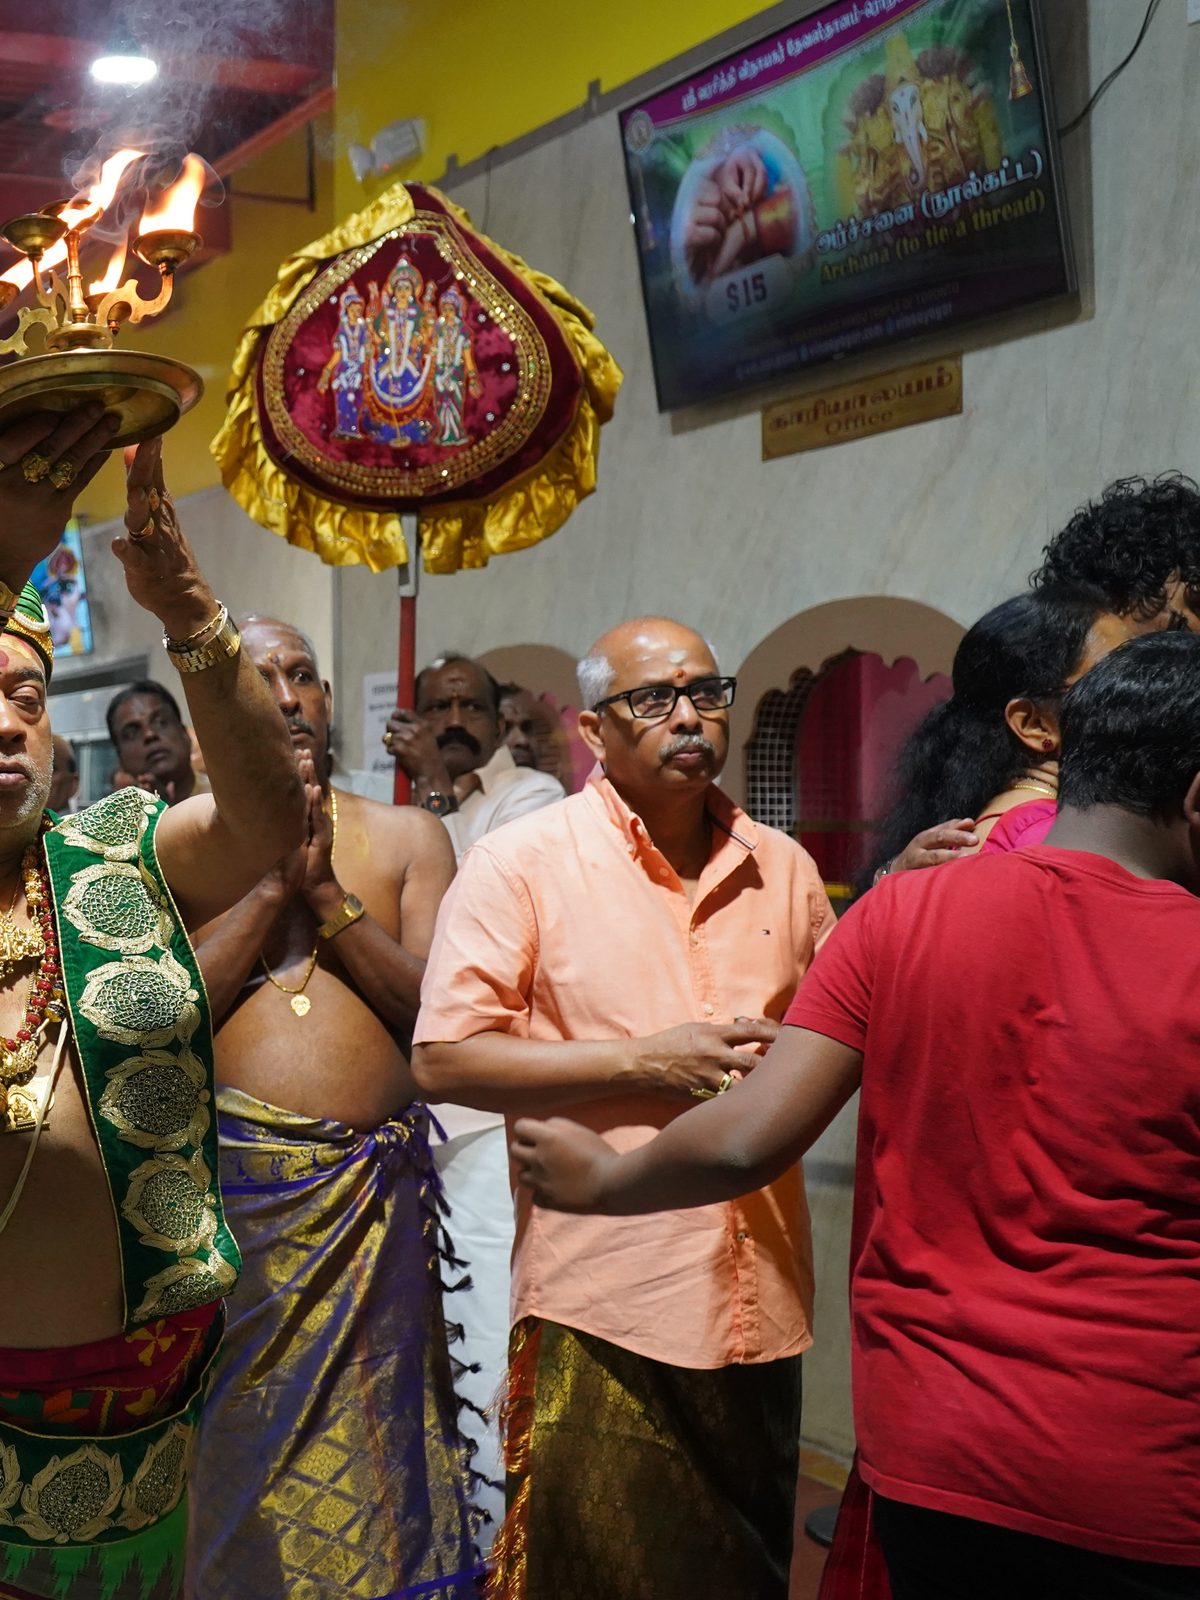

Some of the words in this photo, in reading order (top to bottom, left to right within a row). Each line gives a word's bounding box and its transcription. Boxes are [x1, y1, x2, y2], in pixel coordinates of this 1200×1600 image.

[816, 203, 915, 252] அர்ச்சனை
[921, 148, 1044, 219] (நூல்கட்ட)
[821, 251, 890, 283] Archana
[895, 235, 921, 261] (to
[925, 223, 949, 248] tie
[955, 219, 969, 238] a
[973, 188, 1046, 232] thread)
[725, 273, 768, 313] $15
[769, 365, 954, 432] காரியாலயம்
[825, 411, 893, 436] Office
